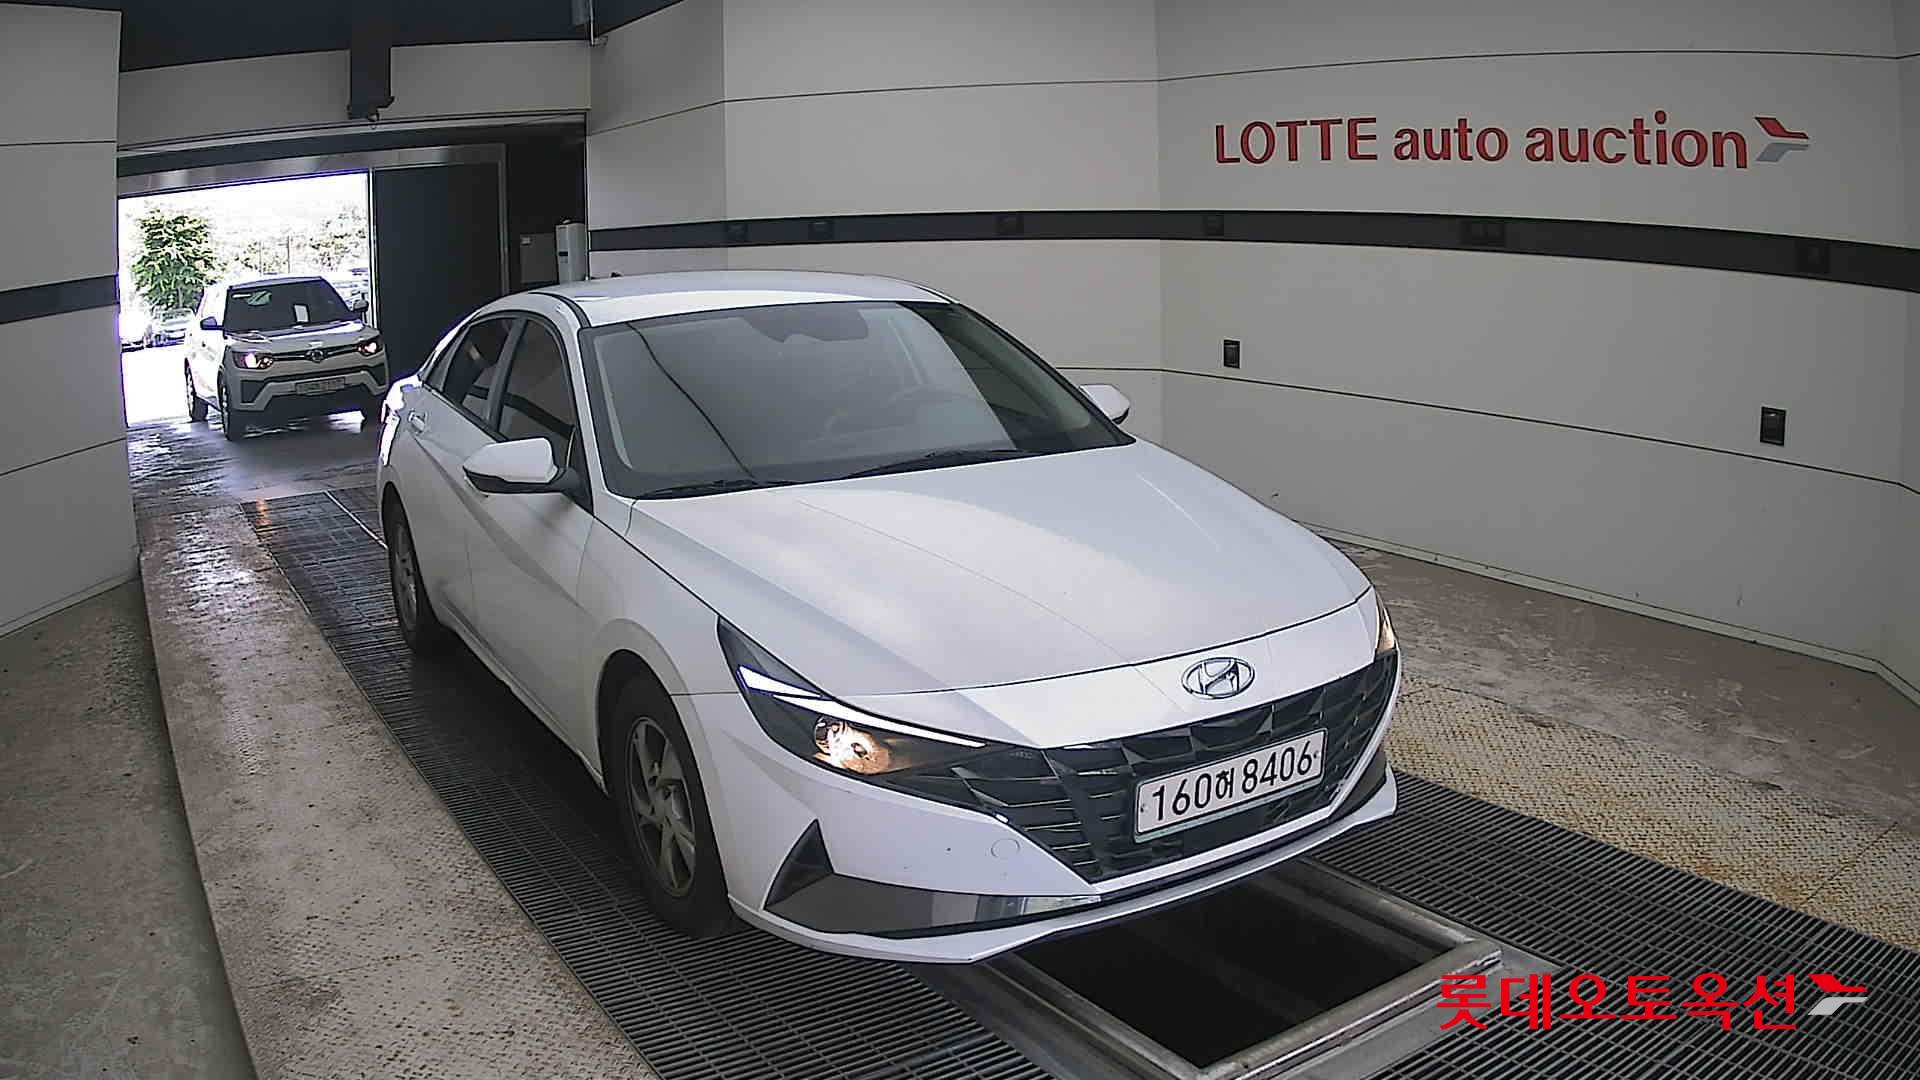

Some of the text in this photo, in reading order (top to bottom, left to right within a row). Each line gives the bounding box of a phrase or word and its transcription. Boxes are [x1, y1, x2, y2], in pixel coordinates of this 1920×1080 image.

[1215, 110, 1749, 169] LOTTE auto auction
[1241, 740, 1313, 794] 8406
